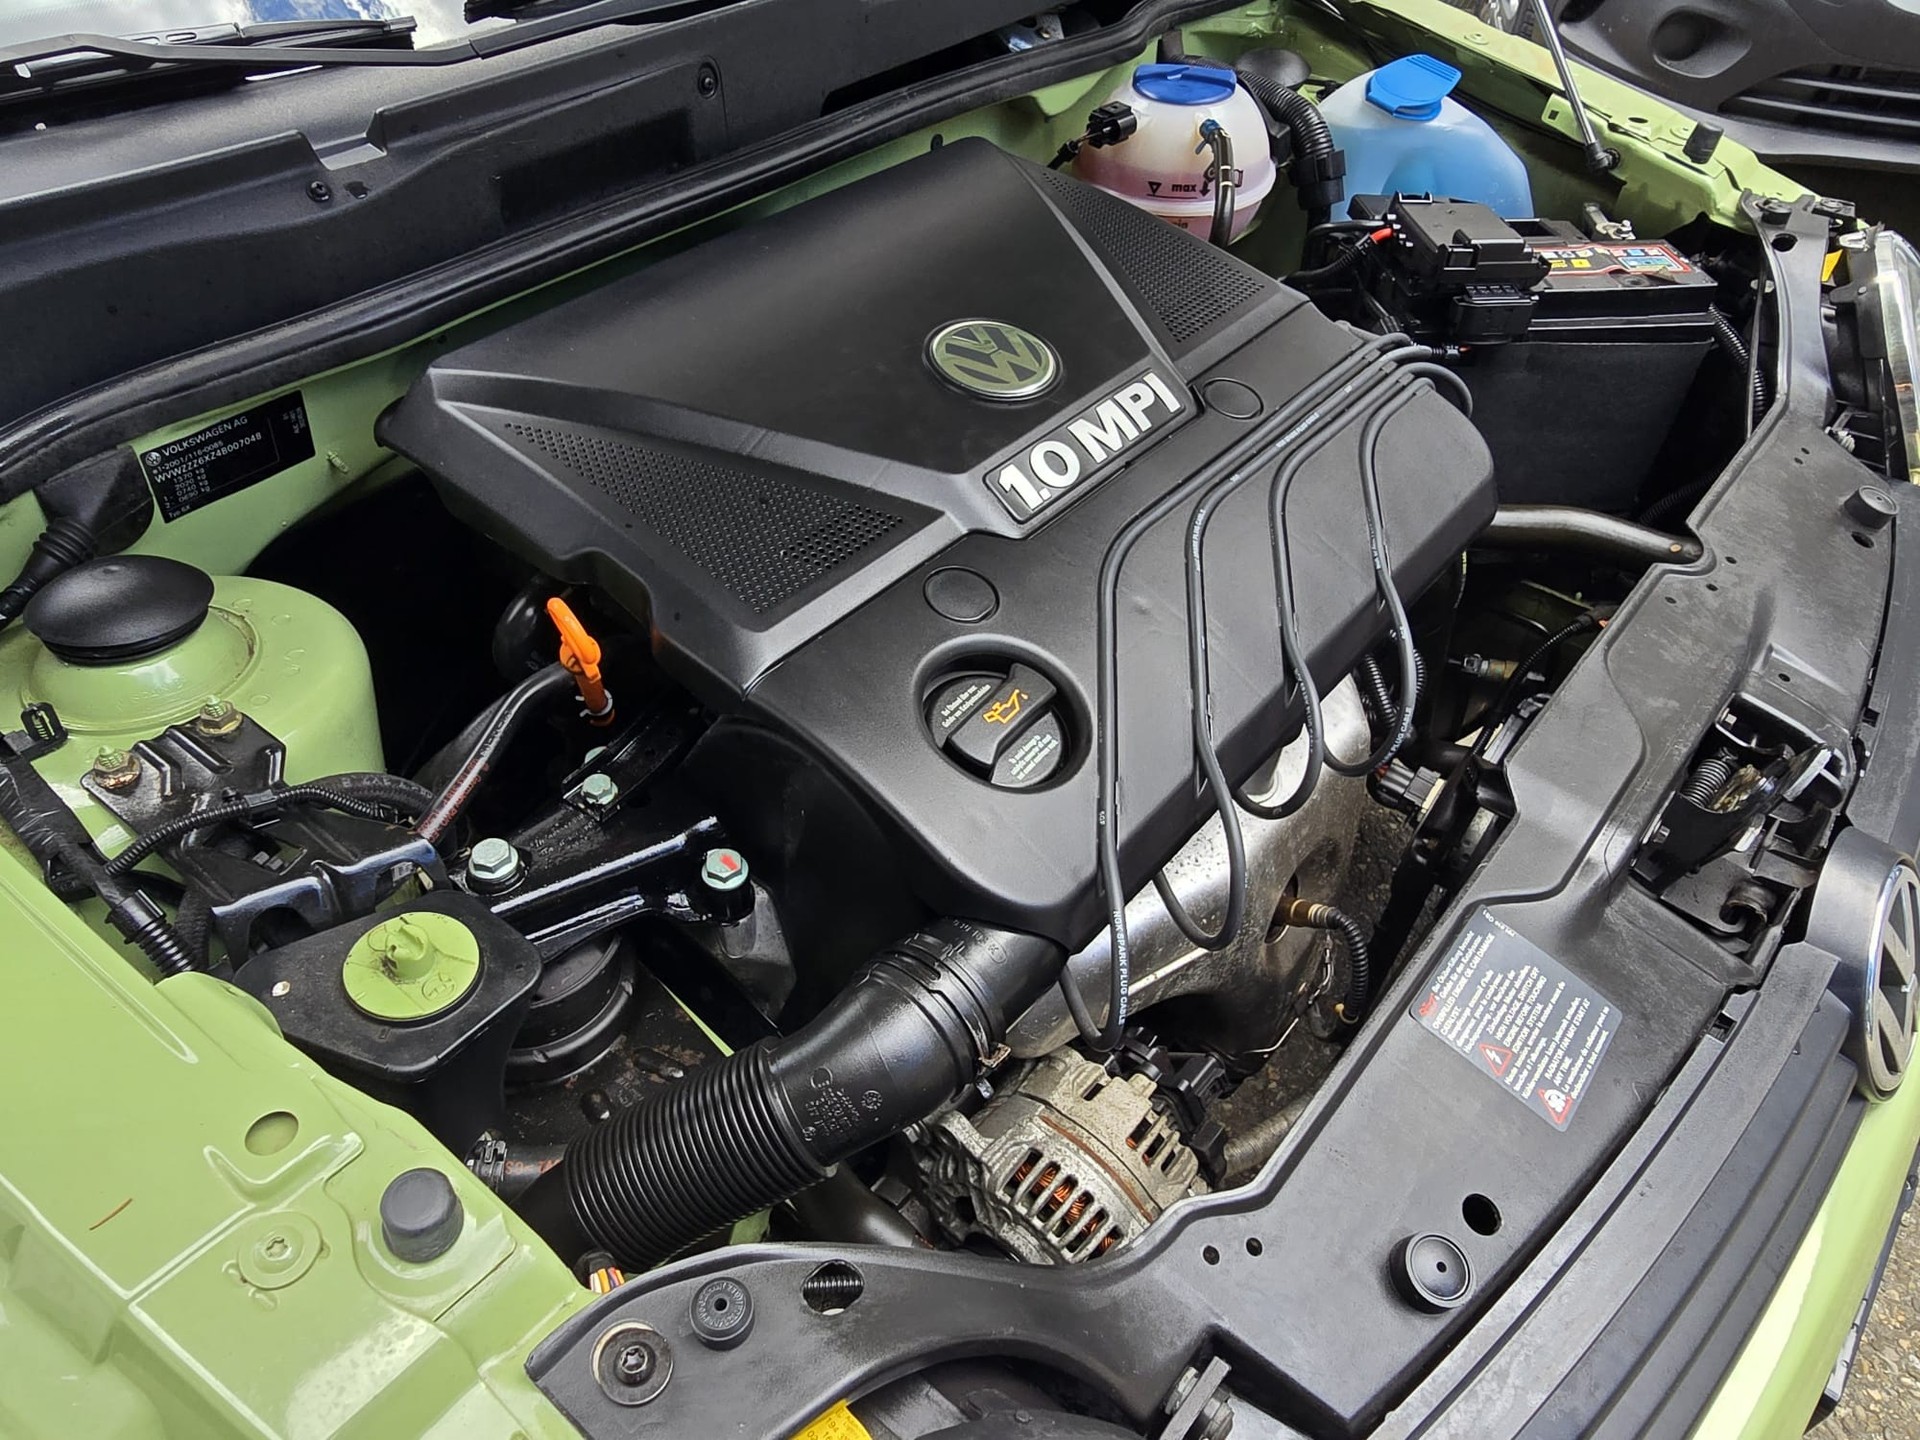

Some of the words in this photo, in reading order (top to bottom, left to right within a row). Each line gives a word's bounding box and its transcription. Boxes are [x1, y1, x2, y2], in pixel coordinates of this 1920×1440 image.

[1172, 183, 1197, 192] max
[162, 422, 231, 456] VOLKSWAGEN
[233, 416, 247, 427] AG
[997, 440, 1080, 510] 1.0
[1067, 372, 1182, 463] MPI
[1391, 733, 1404, 751] PLUG
[1400, 706, 1413, 732] CABLE
[1113, 910, 1123, 932] NGK
[1117, 933, 1127, 968] SPARK
[1469, 955, 1481, 969] CAN
[1119, 968, 1128, 995] PLUG
[1118, 997, 1128, 1026] CABLE
[1494, 1023, 1507, 1040] HIGH
[1517, 977, 1534, 1000] SWITCH
[1530, 966, 1540, 979] OFF
[1502, 1024, 1519, 1046] ENGINE
[1514, 1002, 1531, 1025] BEFORE
[1526, 975, 1547, 1004] TOUCHING
[1511, 1026, 1530, 1053] IGNITION
[1543, 1048, 1564, 1079] RADIATOR
[1559, 1035, 1570, 1050] FAN
[1566, 1023, 1577, 1038] MAY
[1572, 1006, 1586, 1026] START
[1552, 1070, 1564, 1086] ANY
